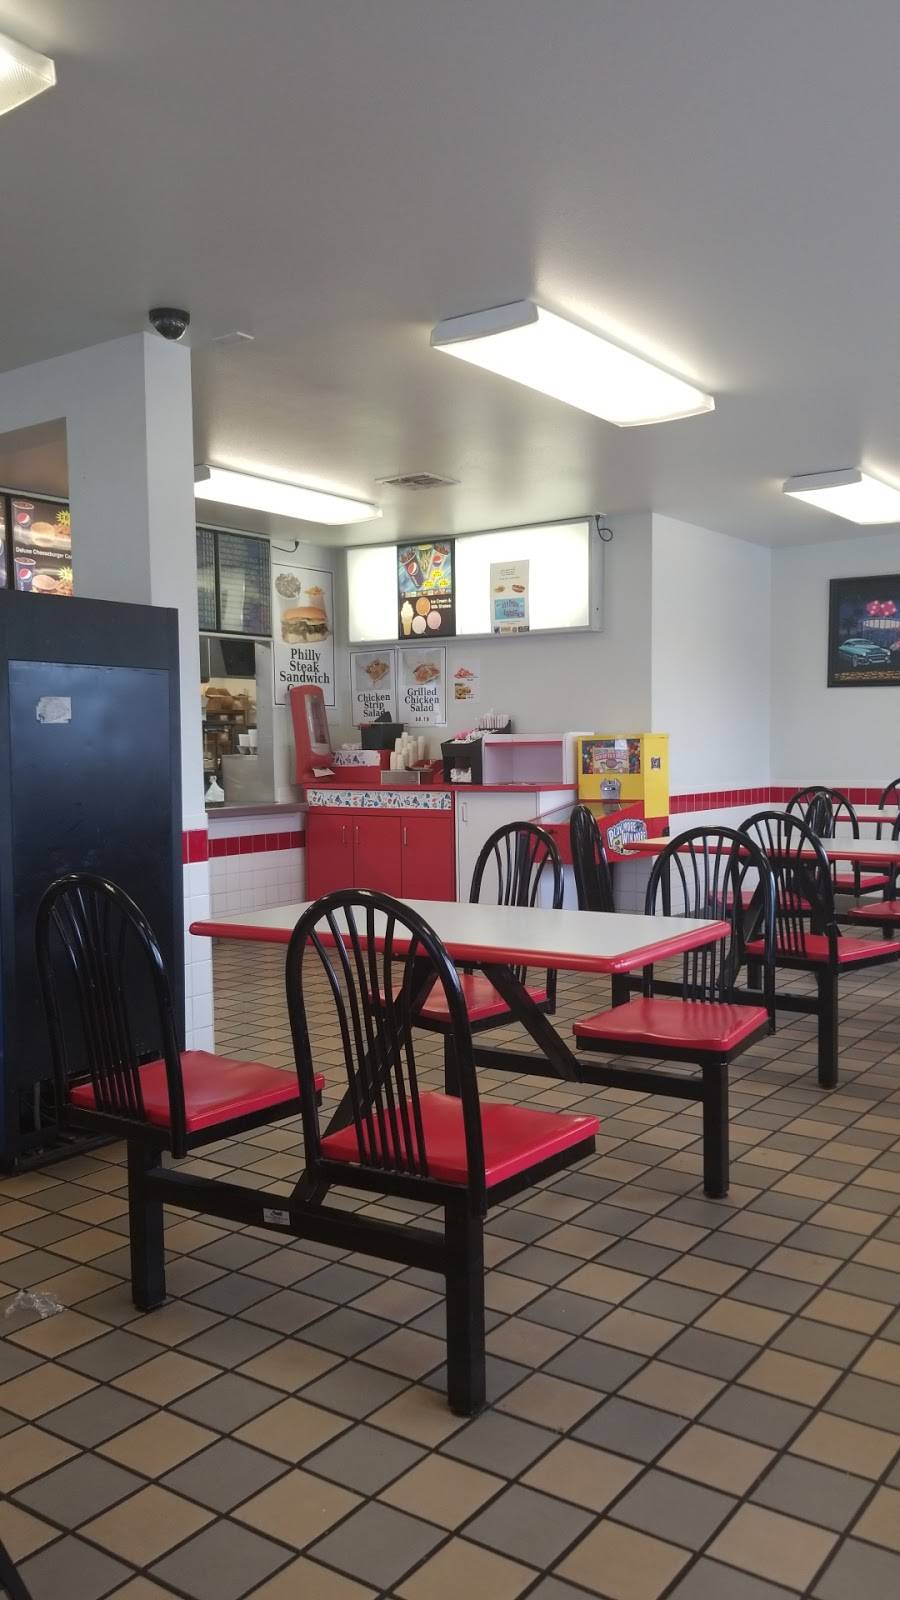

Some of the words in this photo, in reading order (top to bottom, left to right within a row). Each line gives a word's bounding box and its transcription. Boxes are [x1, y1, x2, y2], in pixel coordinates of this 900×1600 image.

[33, 549, 64, 559] Cheeseburger
[290, 648, 321, 661] Philly
[289, 660, 320, 672] Steak
[280, 670, 330, 684] Sandwich
[407, 687, 437, 696] Grilled
[357, 692, 391, 702] Chicken
[404, 695, 440, 704] Chicken
[364, 700, 385, 710] Strip
[410, 703, 434, 712] Salad
[608, 822, 623, 847] PLAY
